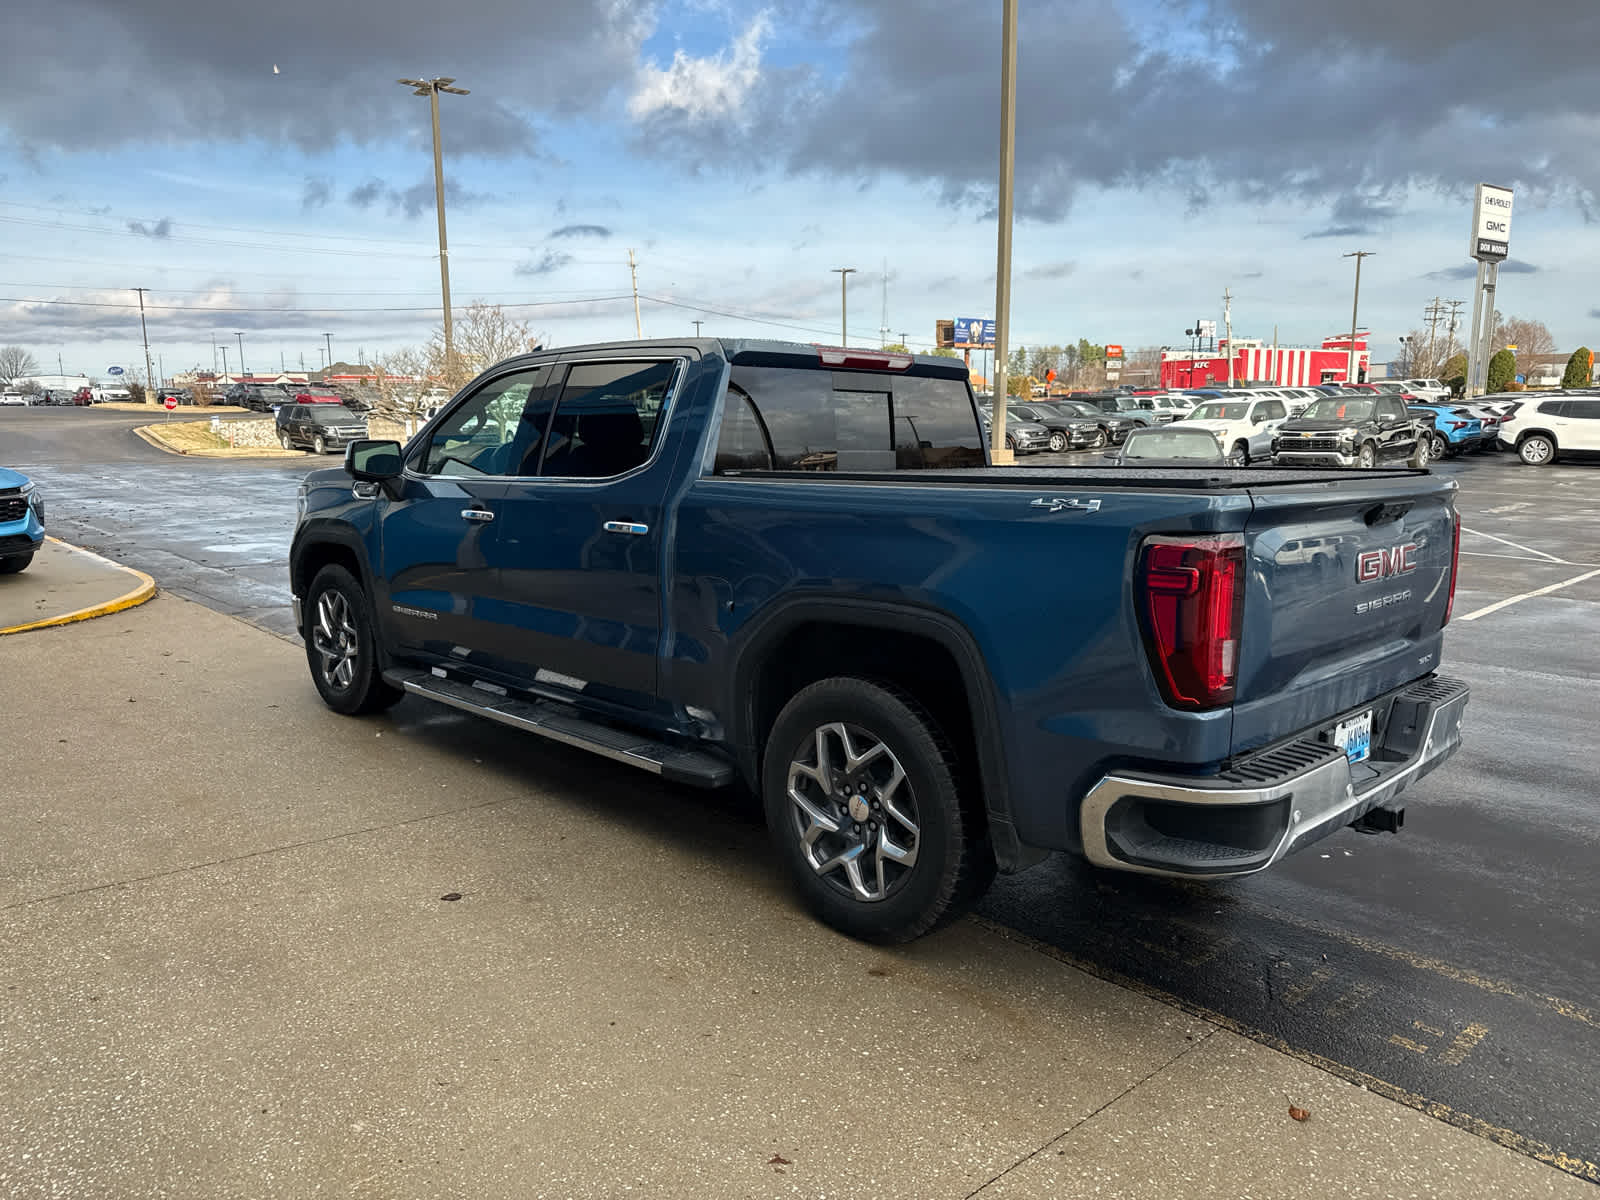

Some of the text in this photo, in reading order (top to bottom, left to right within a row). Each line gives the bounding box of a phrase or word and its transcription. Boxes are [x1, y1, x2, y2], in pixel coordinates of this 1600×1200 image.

[1485, 196, 1511, 208] CHEVROLET
[1486, 221, 1506, 232] GMC
[1357, 543, 1417, 584] GMC
[1355, 590, 1411, 614] SIERRA
[392, 605, 438, 620] SIERRA
